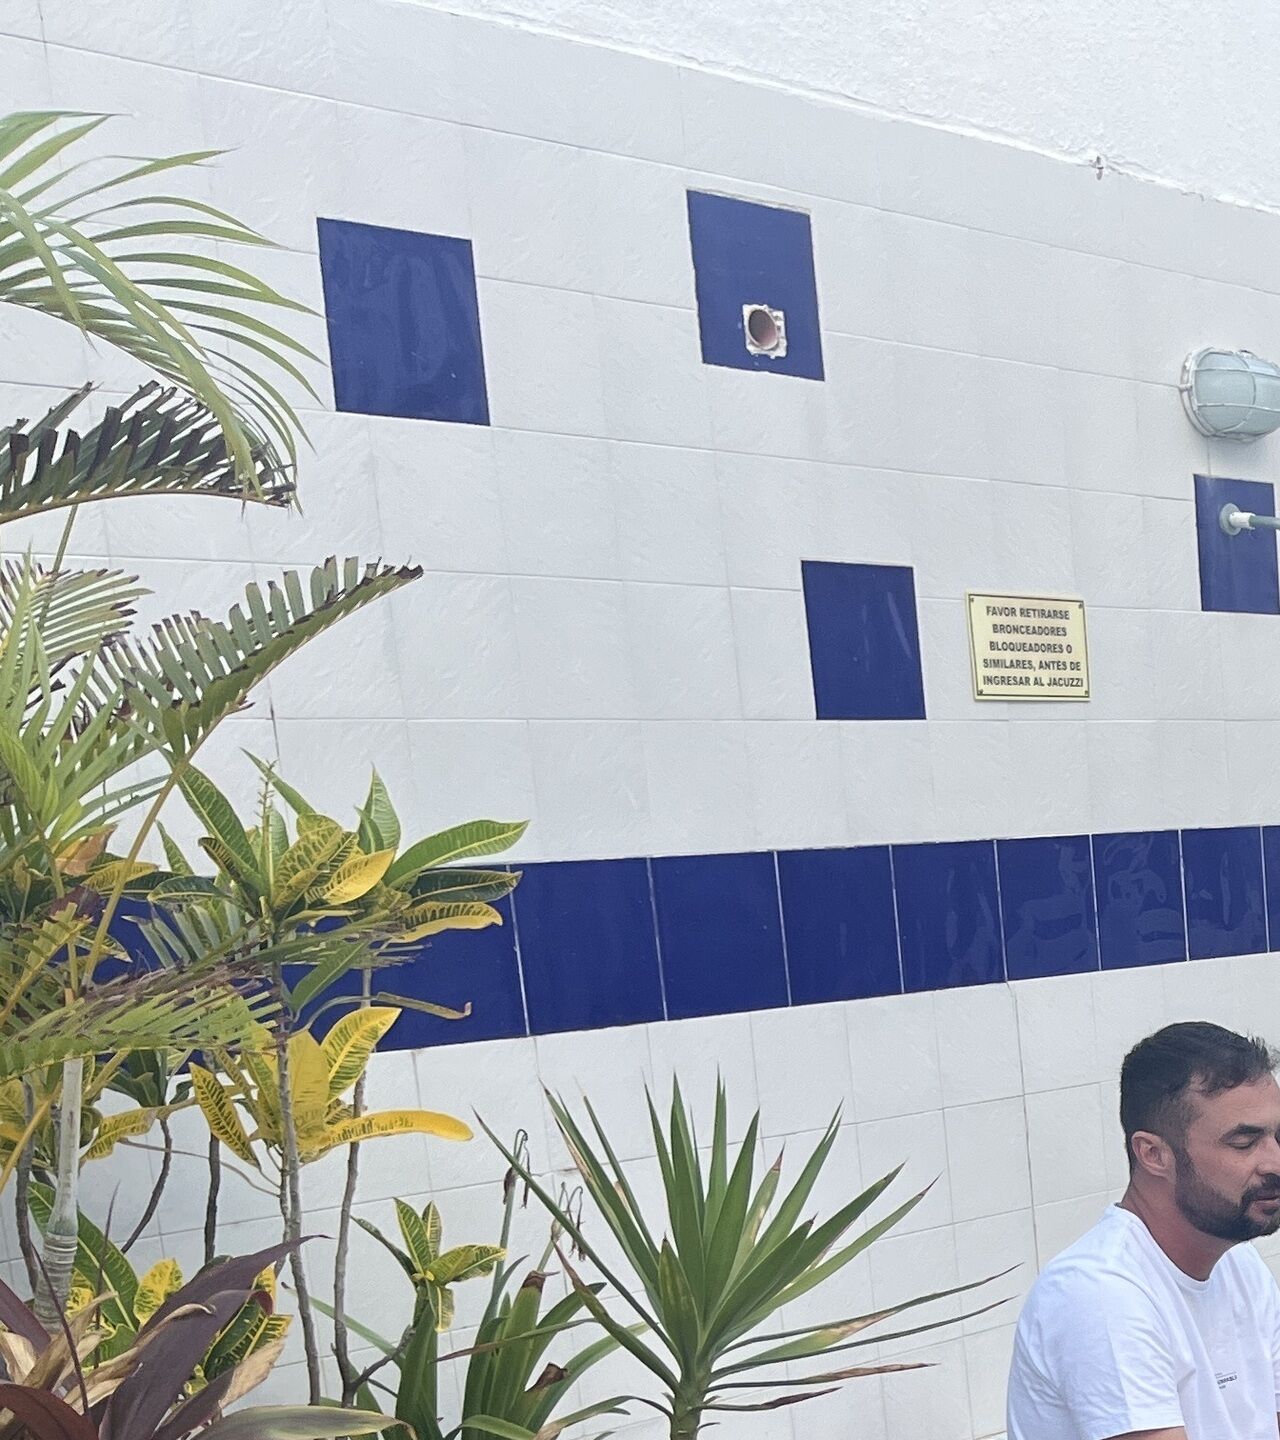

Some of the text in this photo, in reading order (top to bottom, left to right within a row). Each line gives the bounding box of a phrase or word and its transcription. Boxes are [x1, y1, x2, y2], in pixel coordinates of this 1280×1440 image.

[986, 605, 1070, 620] FAVOR RETIRARSE
[992, 623, 1067, 637] BRONCEADORES
[989, 640, 1073, 654] BLOQUEADORES O
[983, 658, 1081, 672] SIMILARES, ANTES DE
[983, 675, 1084, 688] INGRESAR AL JACUZZI
